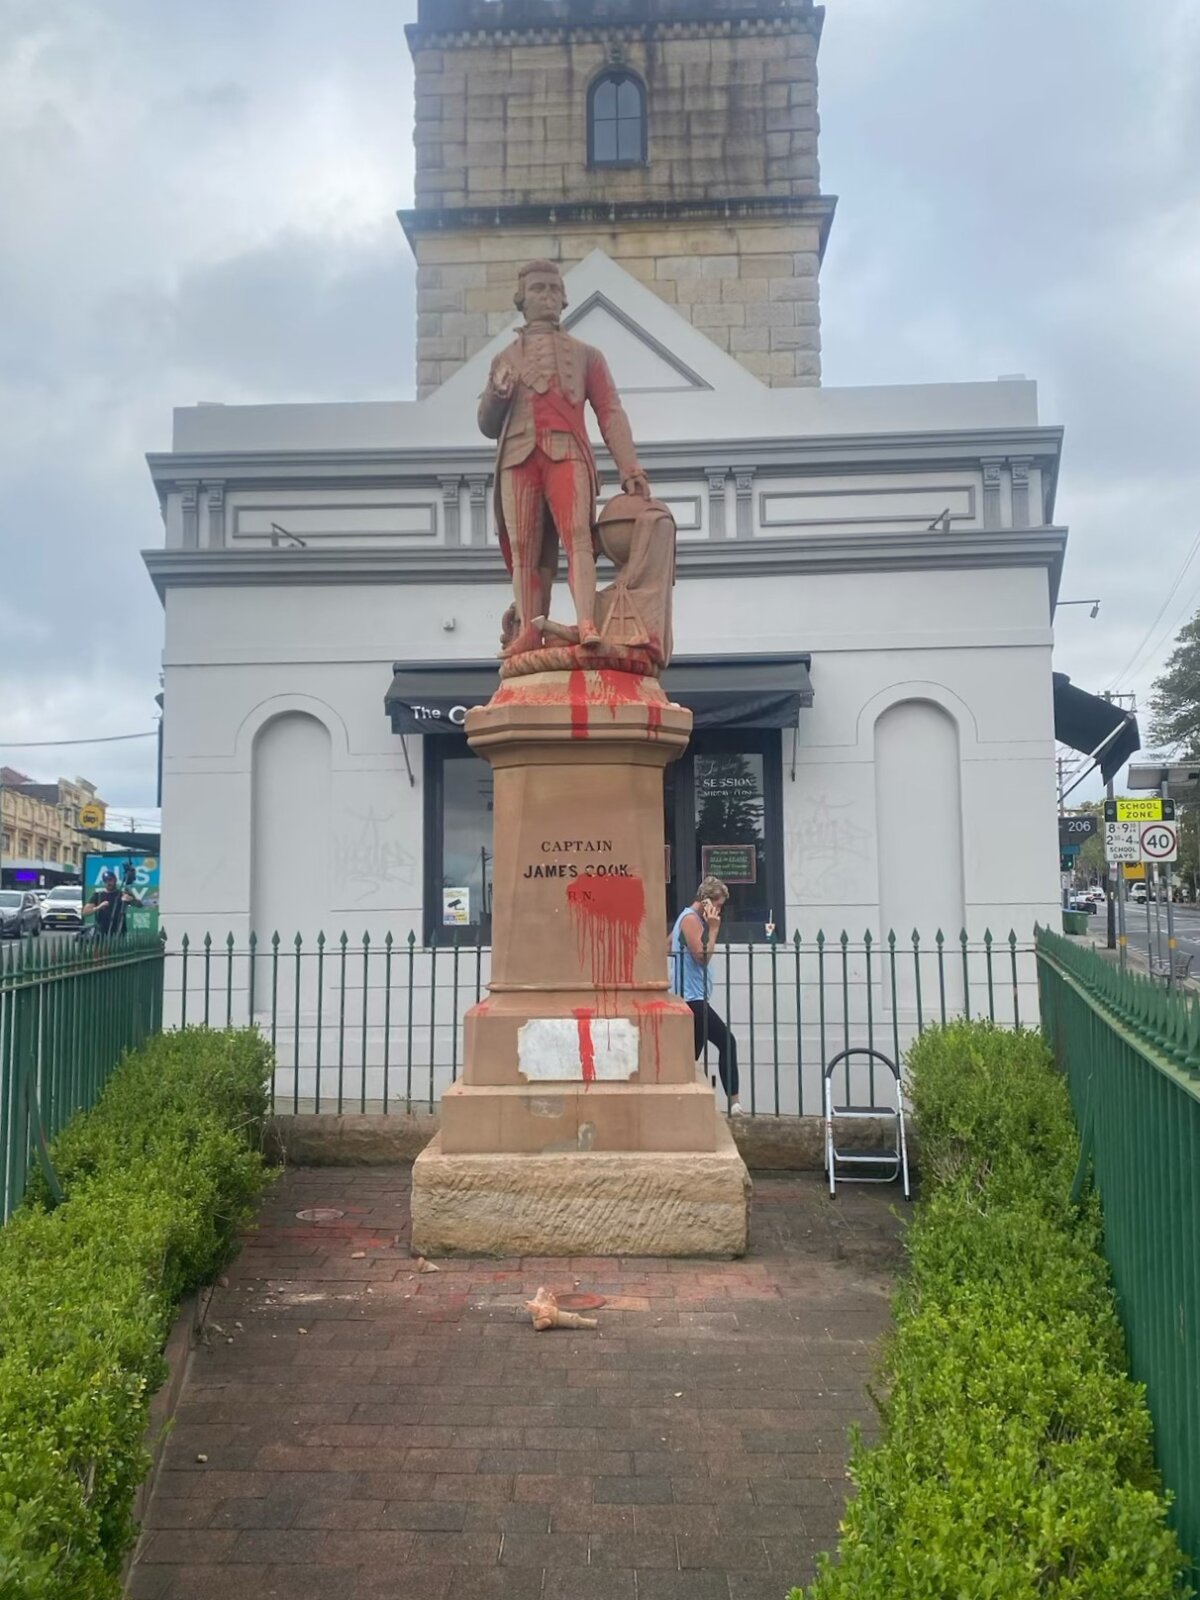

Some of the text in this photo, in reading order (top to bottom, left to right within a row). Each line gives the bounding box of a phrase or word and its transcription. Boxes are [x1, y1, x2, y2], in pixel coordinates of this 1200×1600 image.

[410, 705, 441, 719] The
[1119, 802, 1160, 810] SCHOOL
[1125, 811, 1154, 819] ZONE
[1068, 820, 1092, 832] 206
[541, 840, 613, 853] CAPTAIN
[1146, 833, 1170, 849] 40
[523, 864, 578, 878] JAMES
